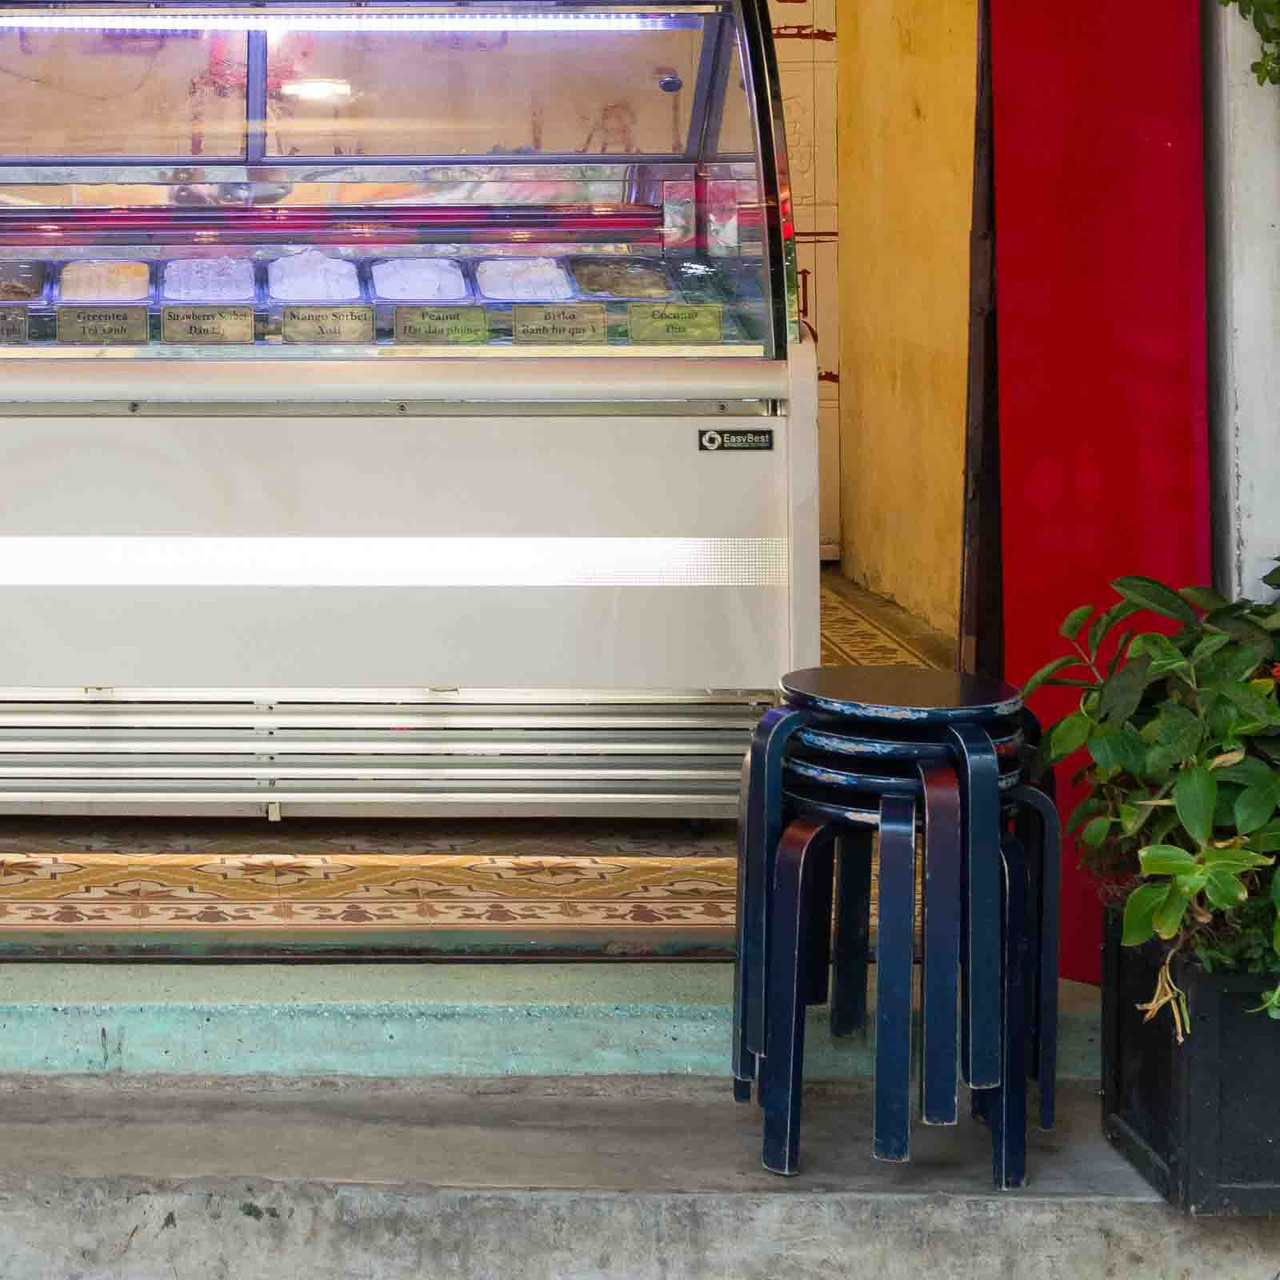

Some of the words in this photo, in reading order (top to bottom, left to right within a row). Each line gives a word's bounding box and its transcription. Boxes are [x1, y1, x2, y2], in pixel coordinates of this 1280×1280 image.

[167, 311, 215, 322] Strawberry
[290, 311, 328, 322] Mango
[332, 311, 367, 321] Sorbet
[723, 433, 769, 443] EasyBest
